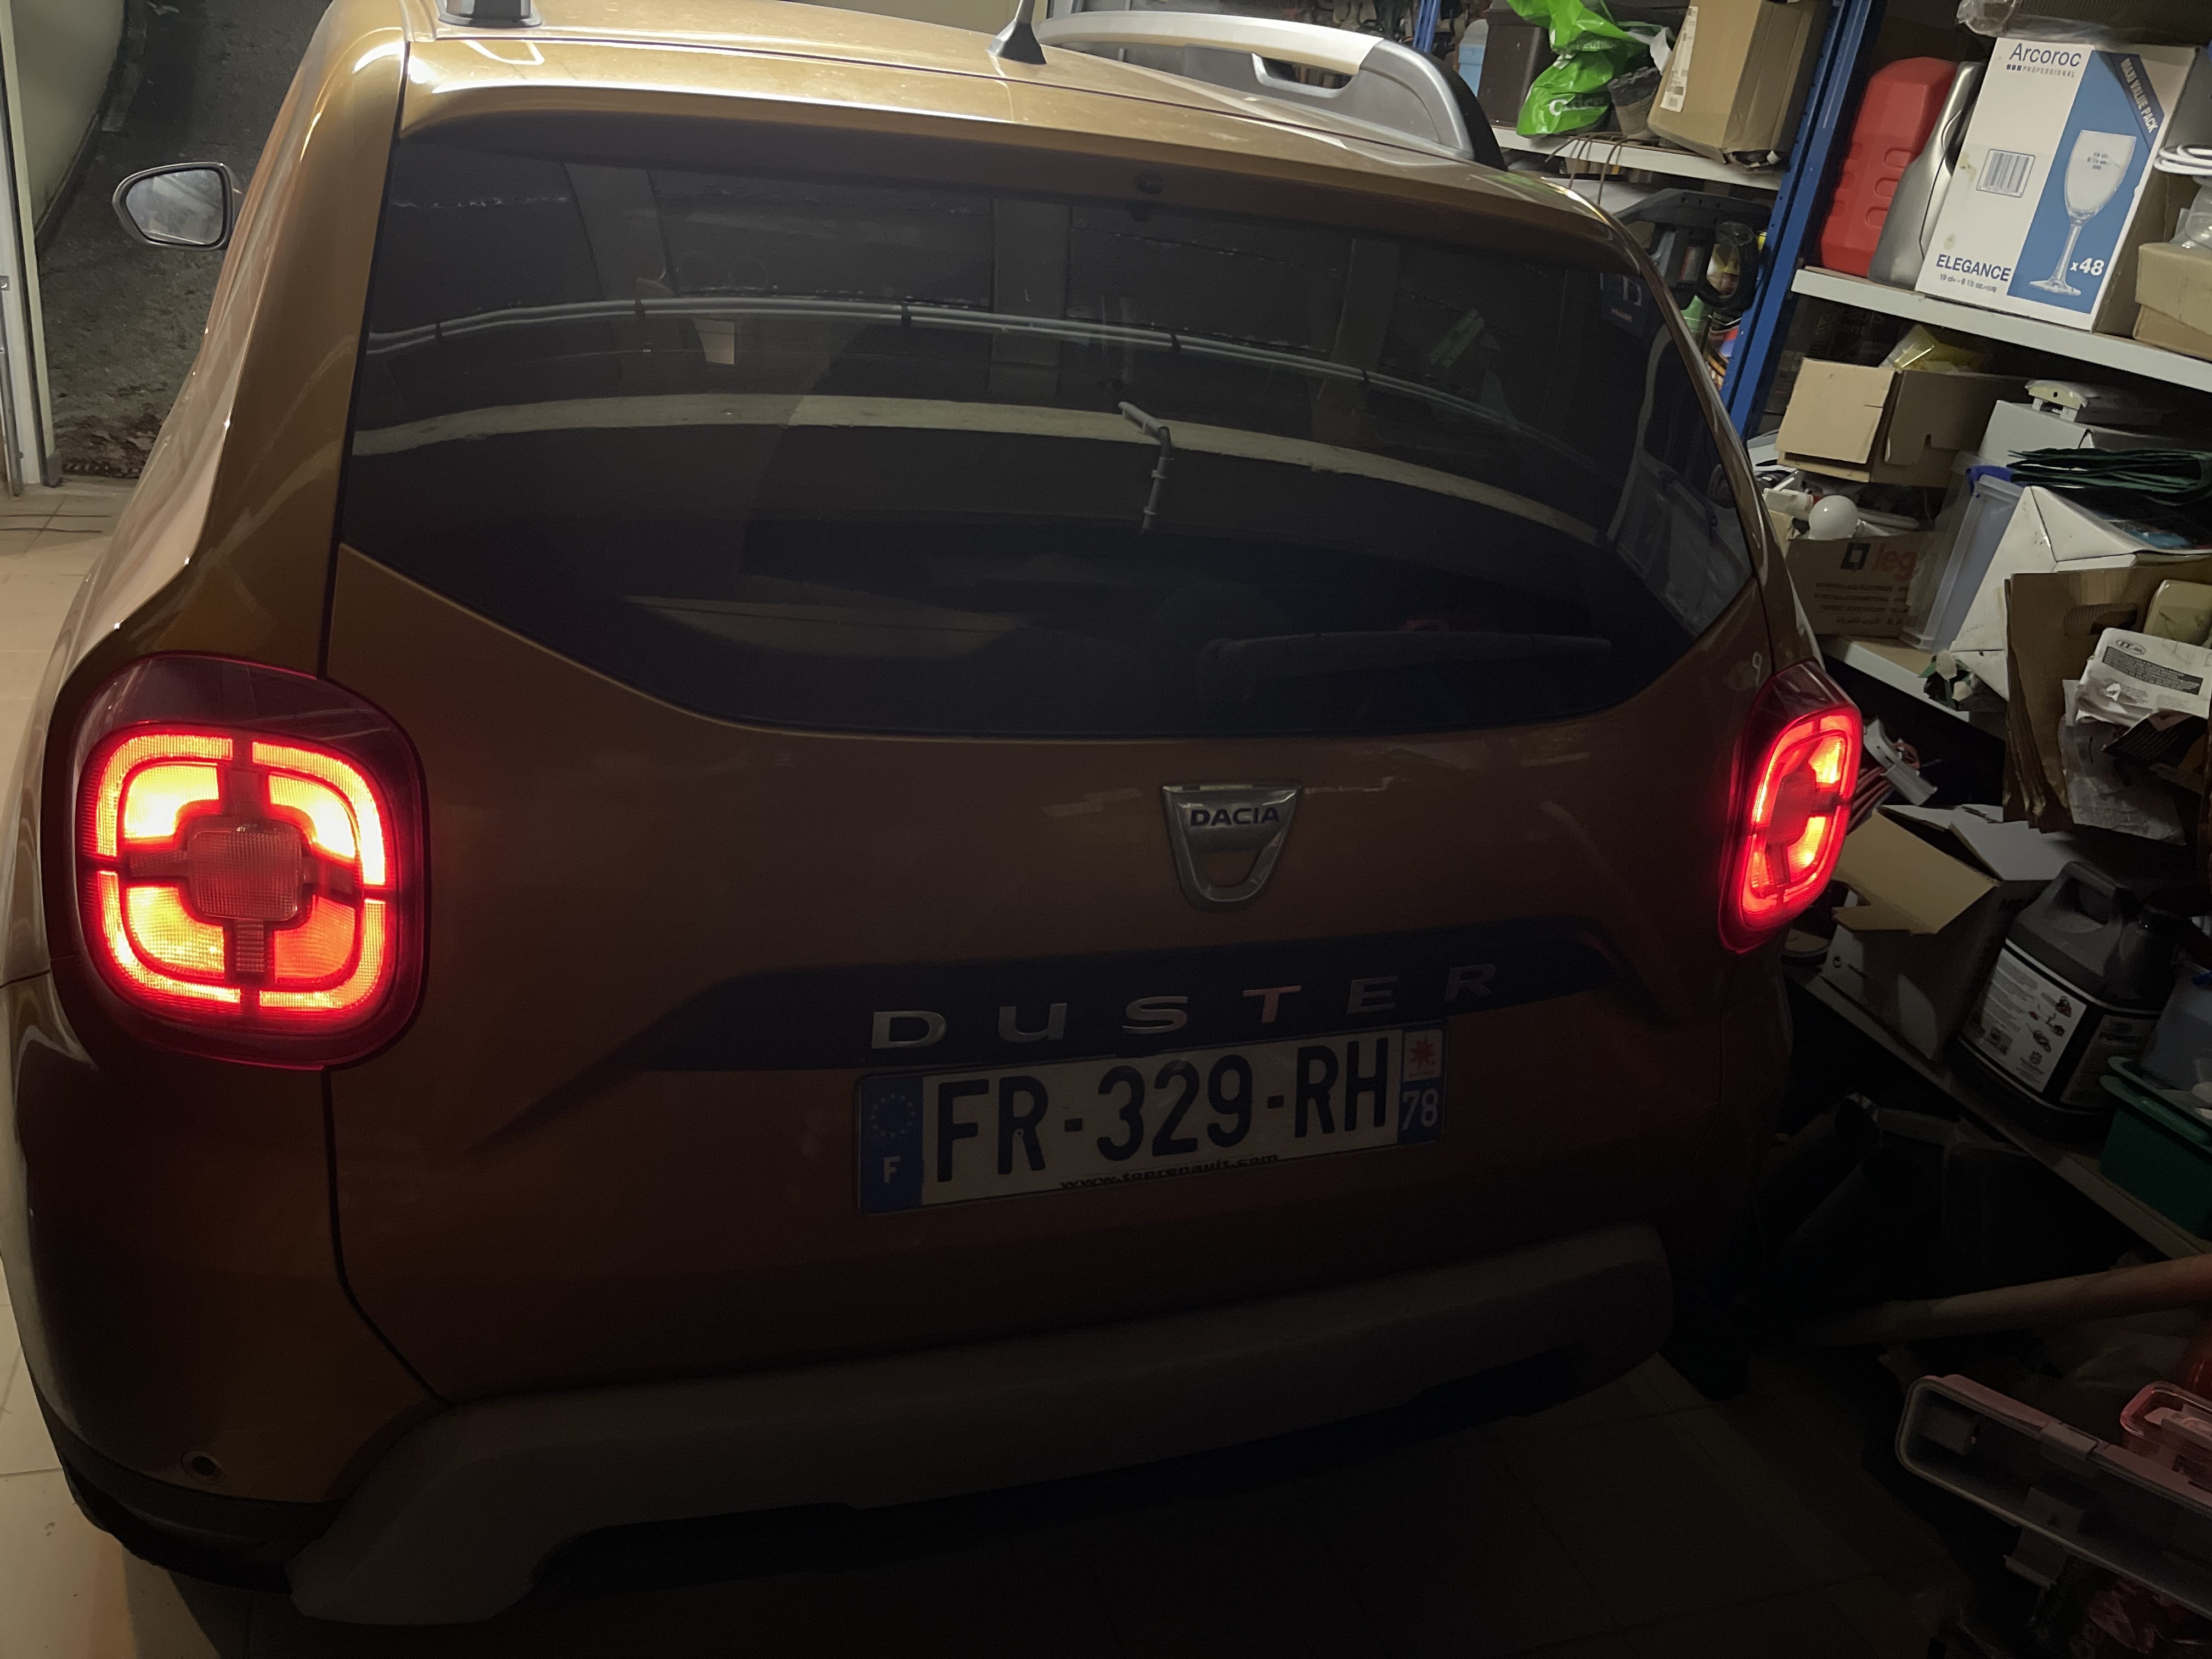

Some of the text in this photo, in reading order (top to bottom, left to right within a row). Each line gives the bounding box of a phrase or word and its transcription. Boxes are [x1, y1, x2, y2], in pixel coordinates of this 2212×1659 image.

[2010, 43, 2081, 67] Arcoroc
[2022, 65, 2075, 78] PROFESSIONAL
[2121, 58, 2159, 134] MAXI VALUE PACK
[1936, 254, 2011, 282] ELEGANCE
[2070, 257, 2105, 276] x48
[1190, 807, 1279, 826] DACIA
[871, 963, 1497, 1049] DUSTER
[938, 1037, 1388, 1182] FR-329-RH
[1401, 1088, 1439, 1131] 78
[883, 1155, 901, 1184] F
